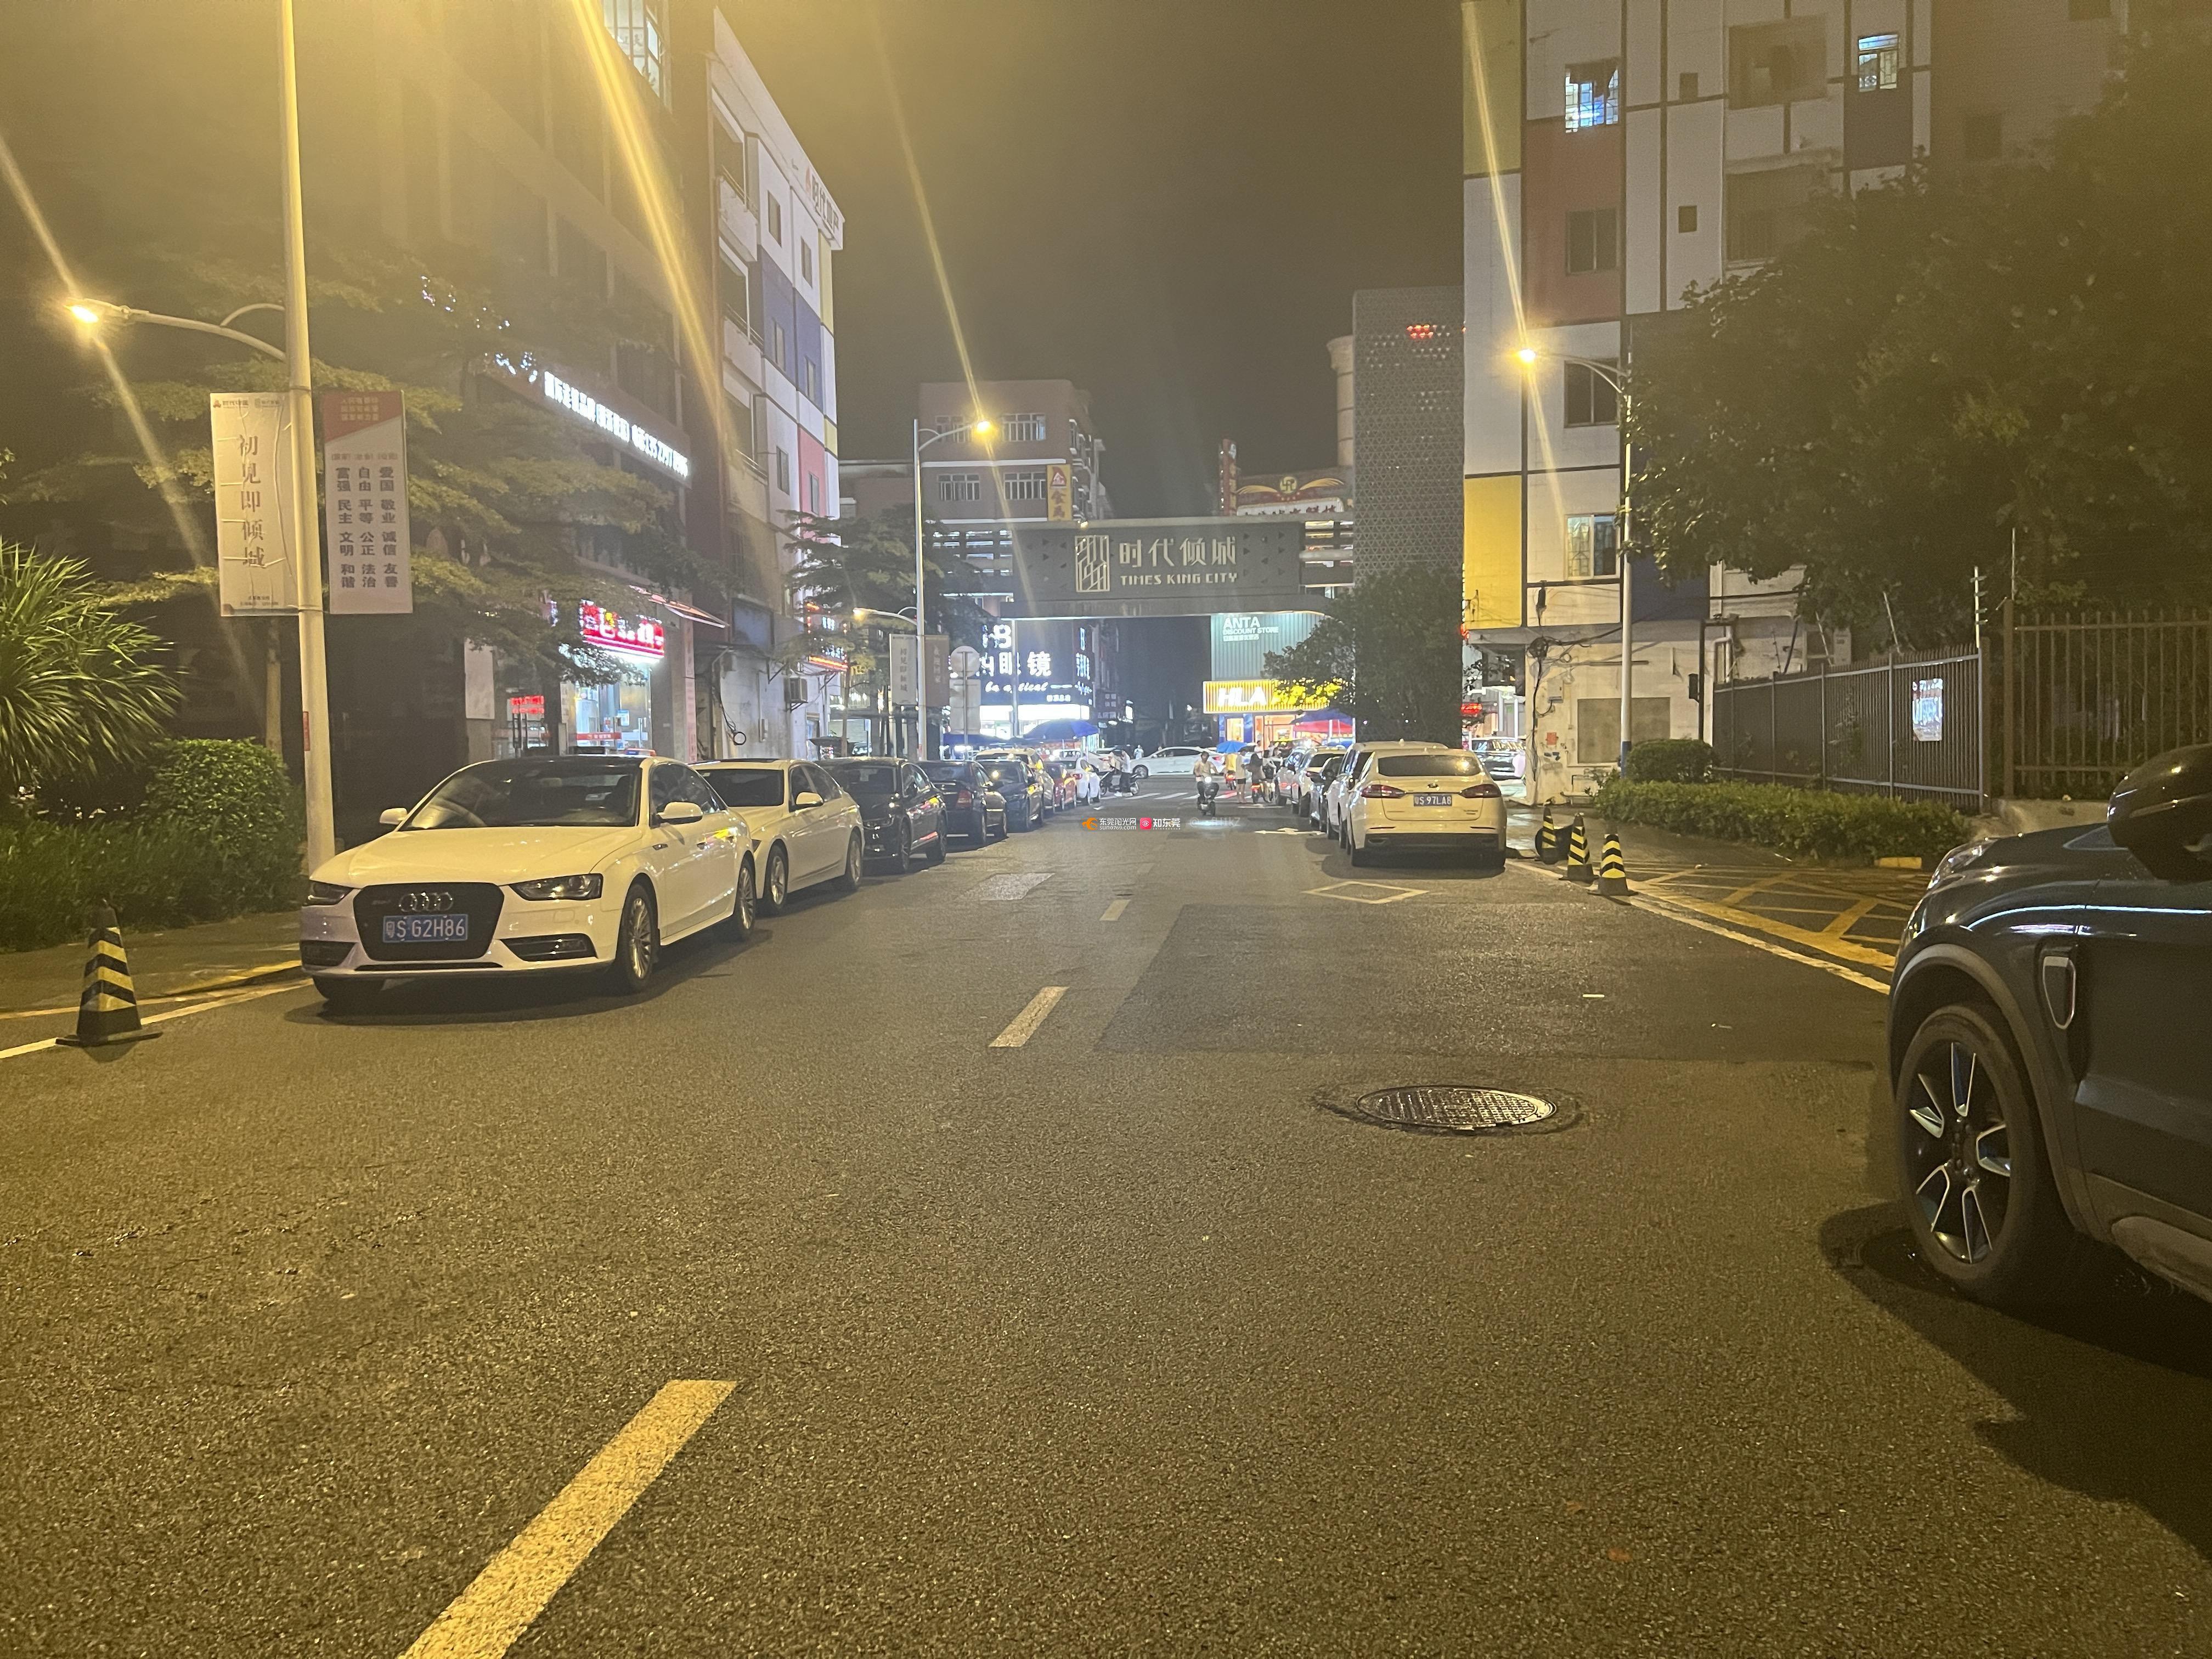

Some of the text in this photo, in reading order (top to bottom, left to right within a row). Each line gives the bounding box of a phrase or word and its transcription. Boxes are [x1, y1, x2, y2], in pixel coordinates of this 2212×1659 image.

[336, 467, 351, 492] 富强
[358, 467, 371, 492] 自由
[380, 467, 394, 492] 爱国
[240, 434, 265, 567] 初见即倾城
[338, 499, 352, 524] 民主
[358, 499, 373, 524] 平等
[381, 499, 396, 523] 敬业
[340, 532, 354, 556] 文明
[360, 532, 375, 556] 公正
[382, 531, 397, 556] 诚信
[1119, 537, 1236, 567] 时代倾城
[341, 563, 355, 588] 和谐
[362, 563, 376, 588] 法治
[383, 563, 398, 588] 友善
[1120, 573, 1237, 585] TIMES KING CITY
[1223, 617, 1260, 629] ANTA
[1218, 686, 1267, 707] HLA
